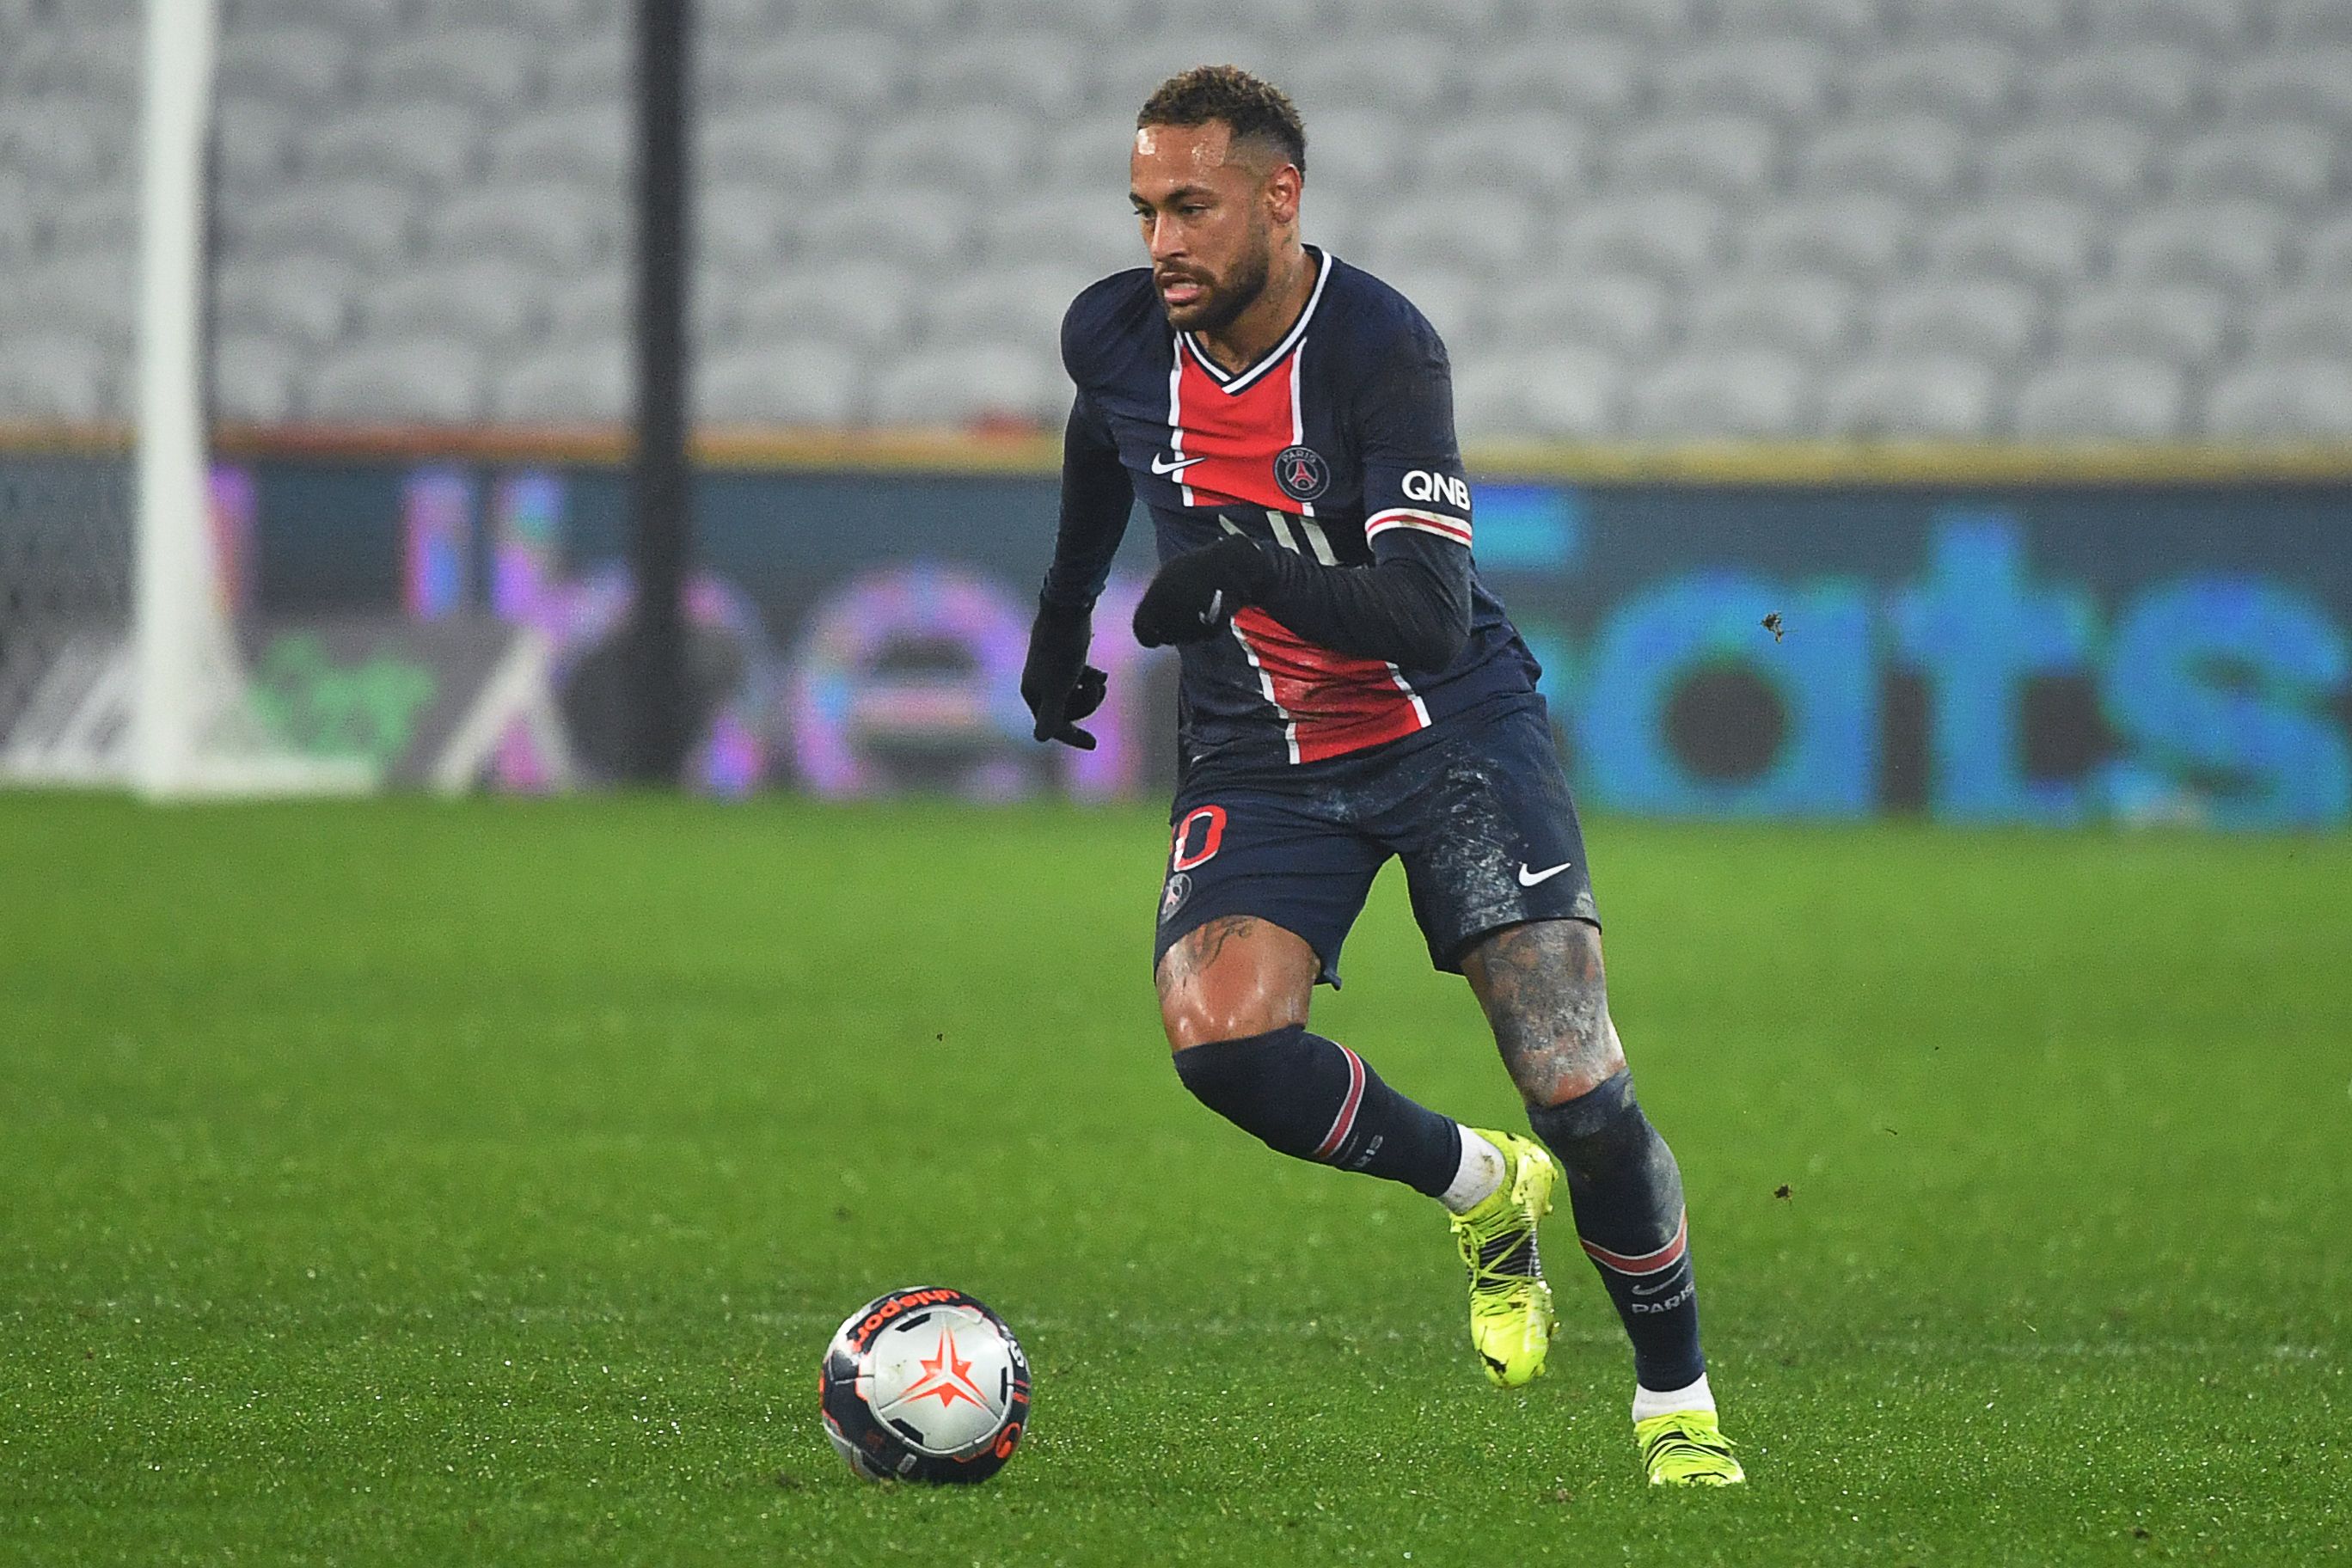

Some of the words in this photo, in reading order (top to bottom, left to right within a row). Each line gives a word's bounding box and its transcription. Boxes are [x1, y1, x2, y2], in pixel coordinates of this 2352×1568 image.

[1281, 450, 1317, 462] PARIS
[1402, 470, 1471, 511] QNB
[1468, 481, 2352, 825] ats
